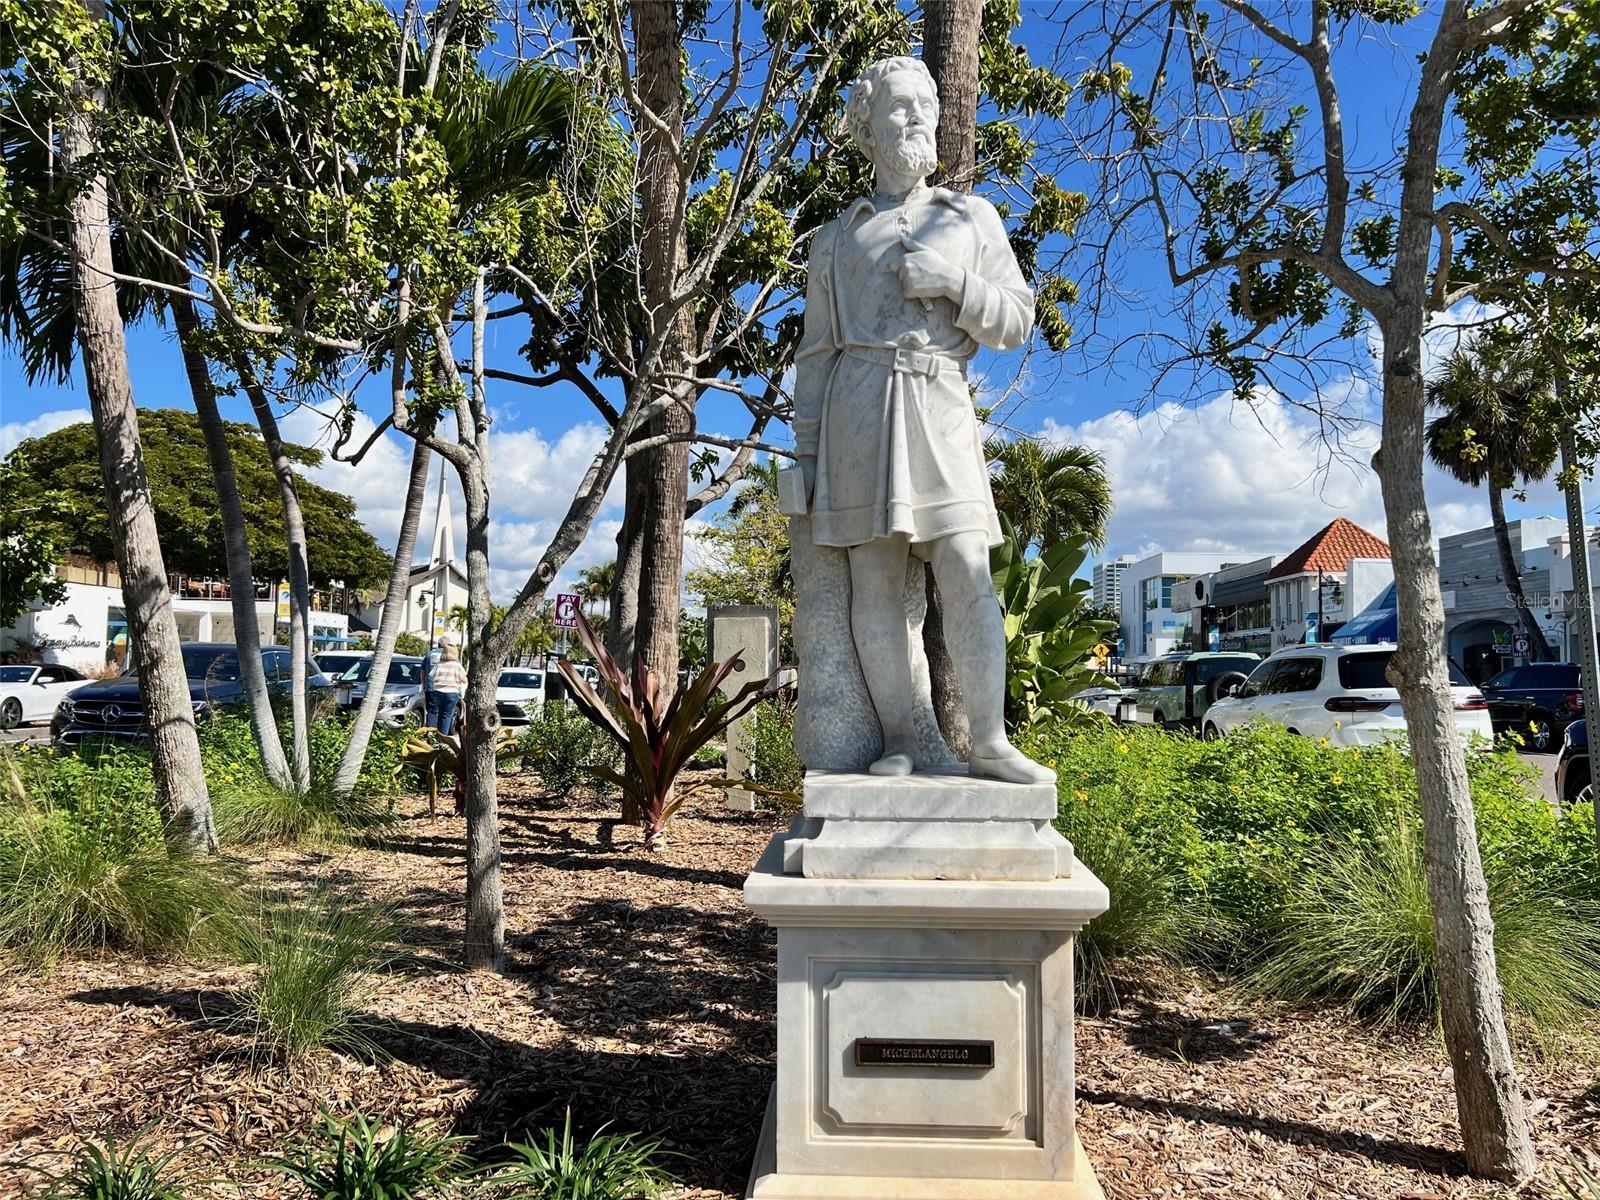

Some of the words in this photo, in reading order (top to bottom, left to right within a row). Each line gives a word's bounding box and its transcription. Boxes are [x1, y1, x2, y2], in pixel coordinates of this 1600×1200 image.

[555, 618, 577, 627] HERE
[69, 635, 101, 648] Bahama
[881, 1048, 969, 1059] MICHELANGELO
